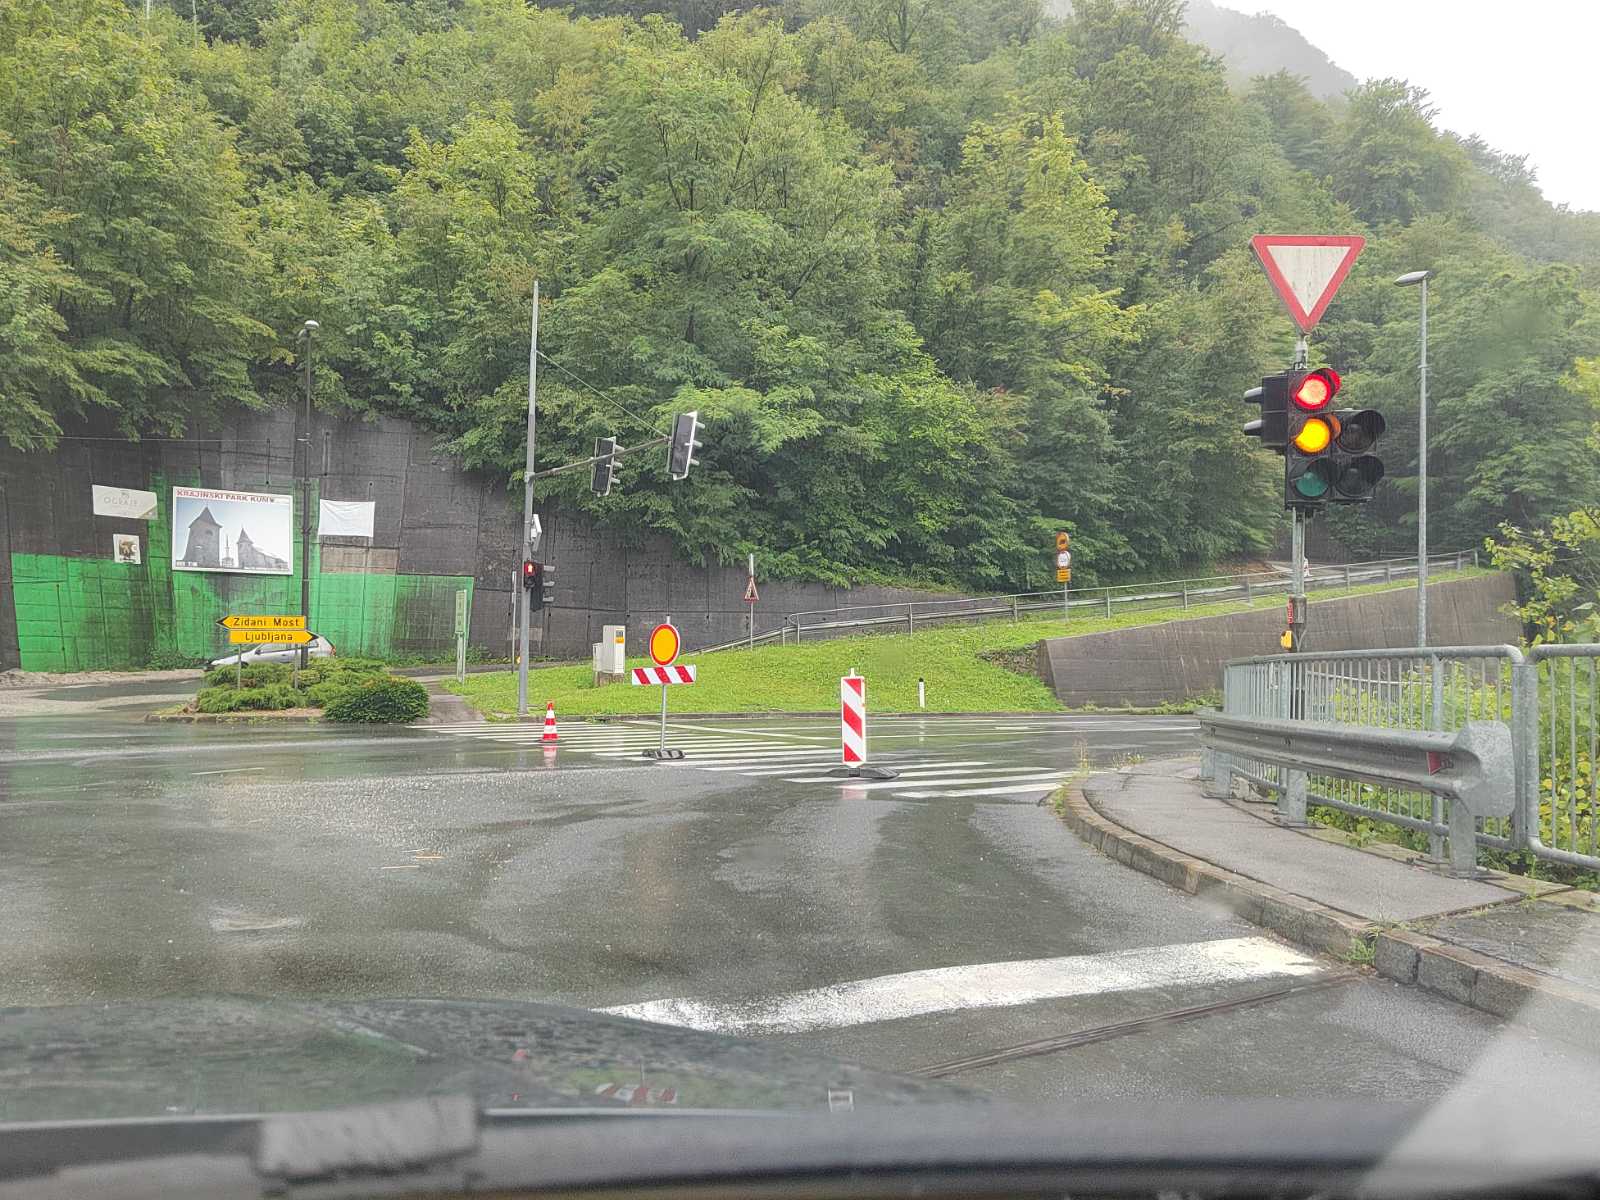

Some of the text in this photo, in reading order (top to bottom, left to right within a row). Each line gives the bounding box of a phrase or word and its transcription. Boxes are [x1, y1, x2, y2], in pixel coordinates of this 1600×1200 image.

[176, 488, 224, 500] KRAJINSKI
[226, 493, 249, 502] PARK
[234, 617, 300, 627] Zidani Most
[245, 631, 293, 642] Ljubljana
